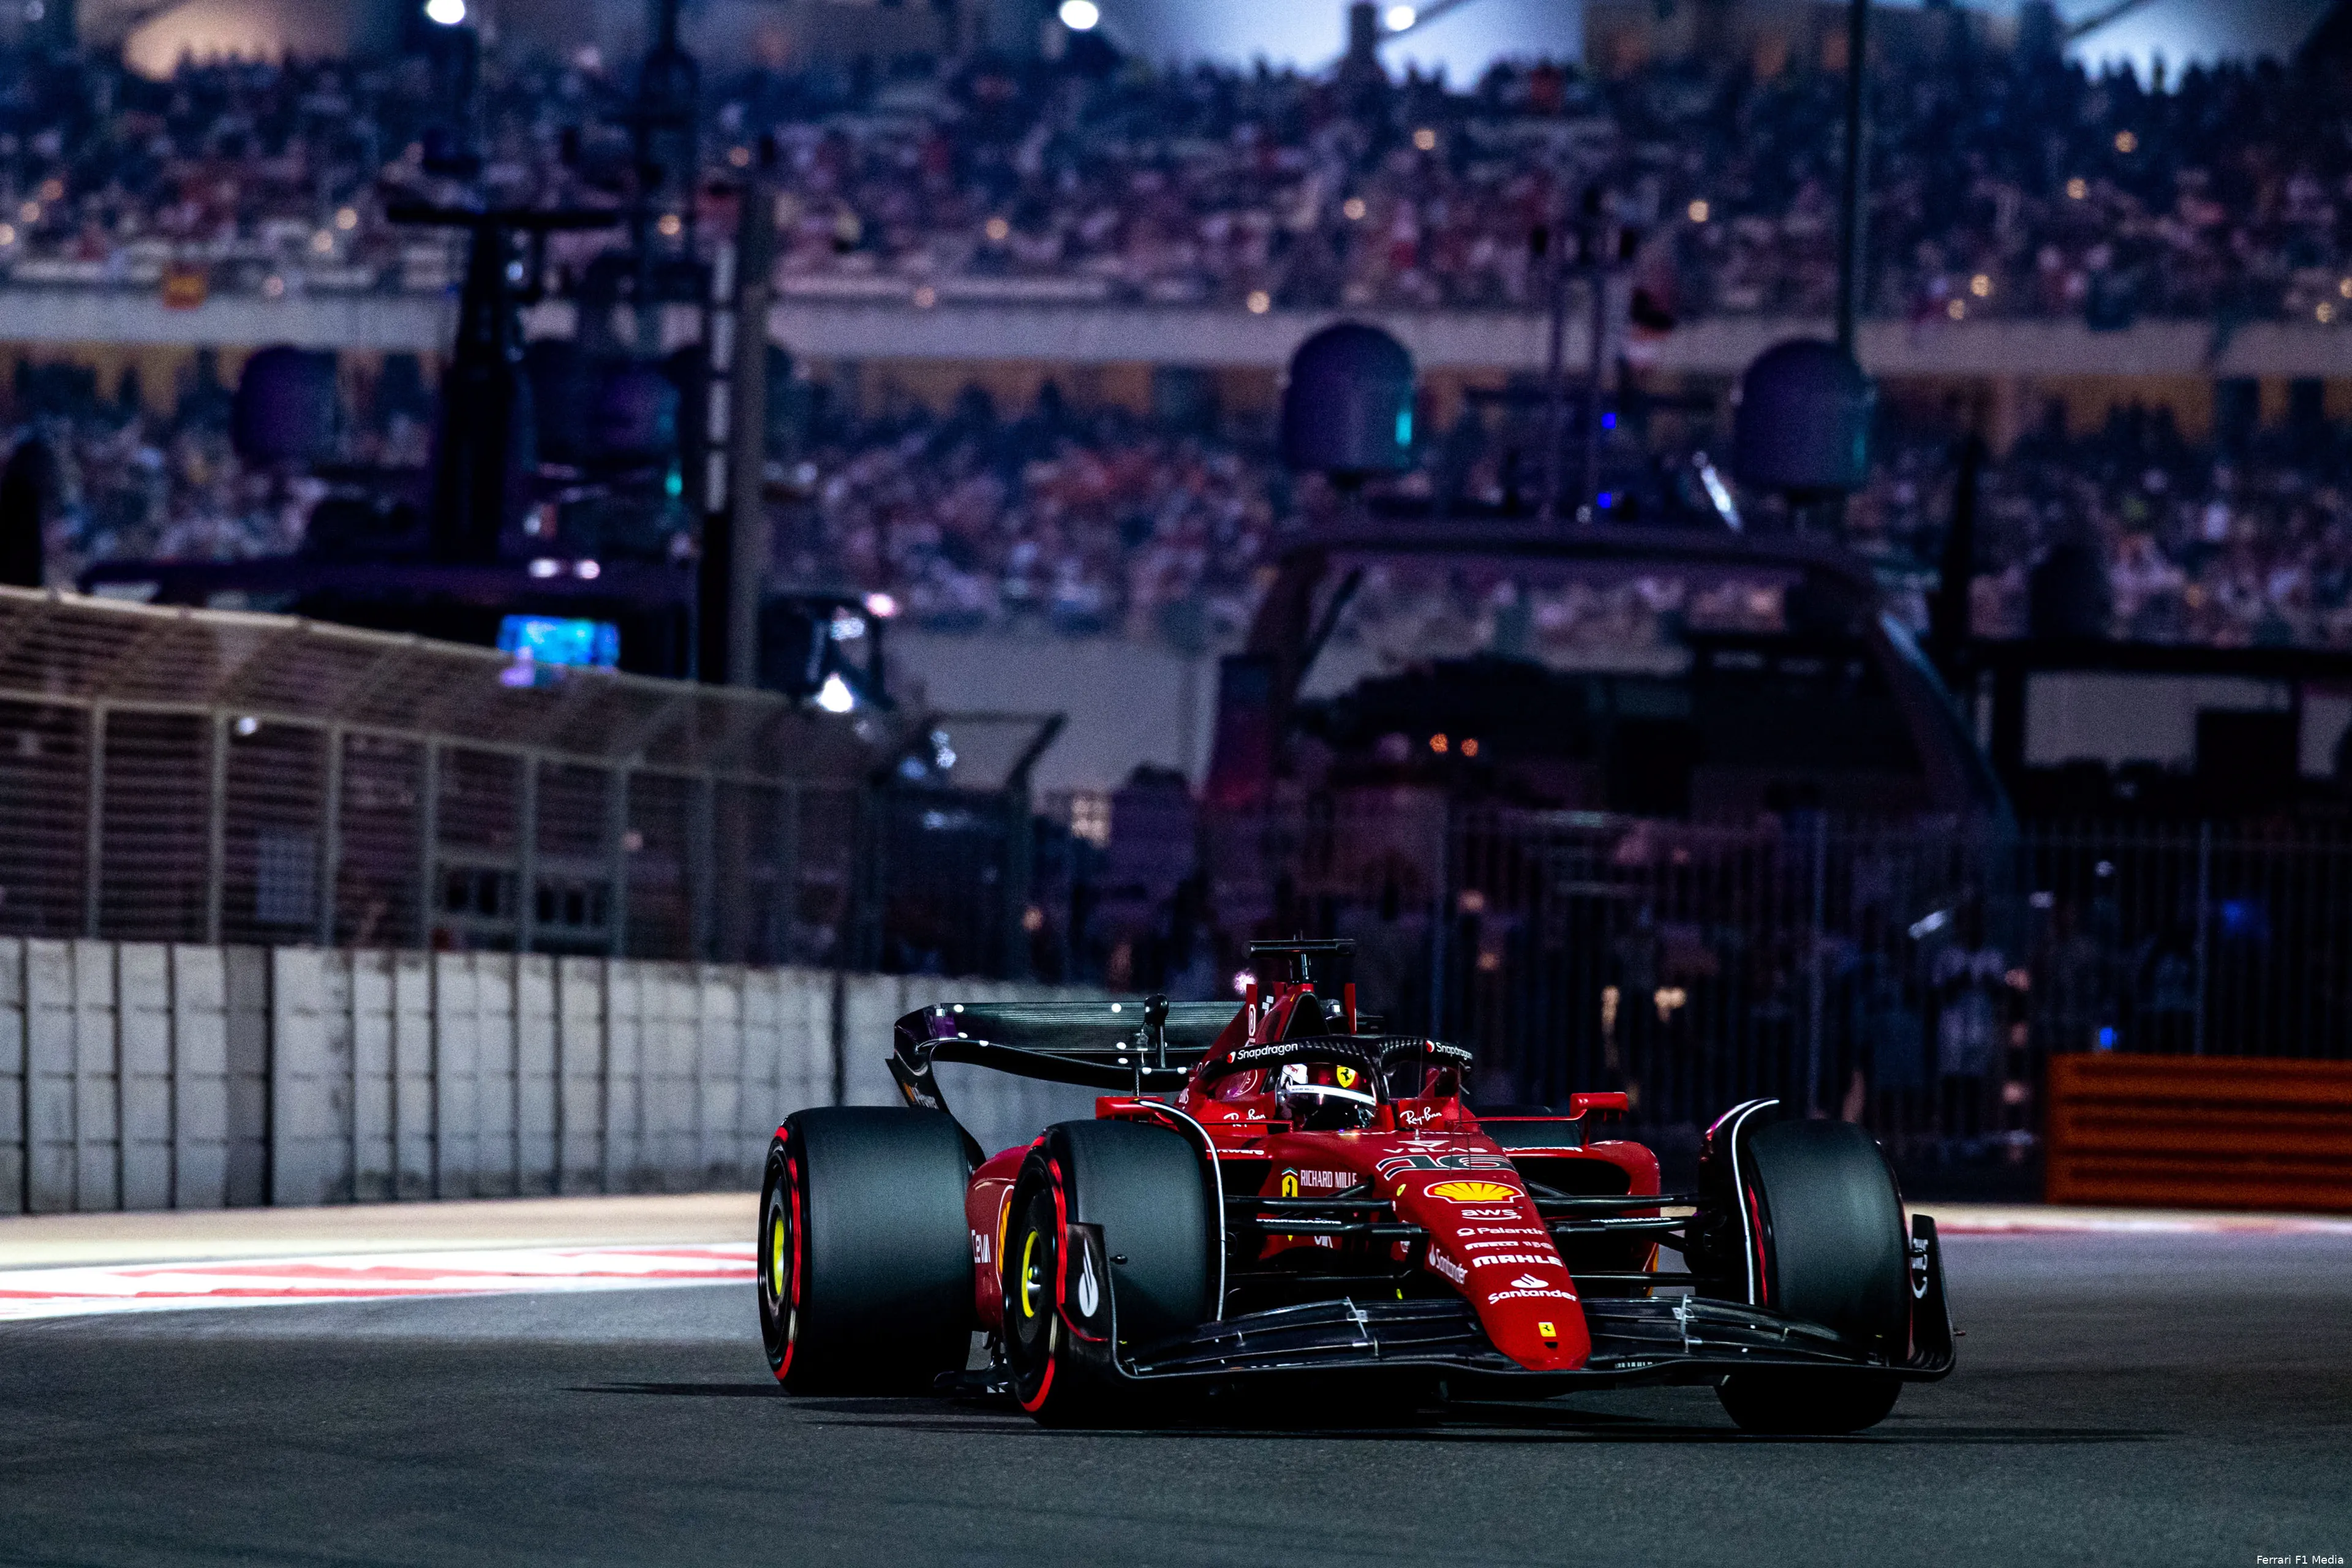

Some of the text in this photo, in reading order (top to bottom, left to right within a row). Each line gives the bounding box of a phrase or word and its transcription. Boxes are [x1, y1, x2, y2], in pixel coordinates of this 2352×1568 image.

[1237, 1043, 1298, 1059] Snapdragon
[1436, 1042, 1472, 1060] Snapdragon
[1400, 1107, 1442, 1125] Ray-Ban
[1376, 1155, 1518, 1181] 16
[1300, 1170, 1357, 1188] RICHARD MILLE
[1472, 1255, 1563, 1268] MAHLE
[1488, 1289, 1577, 1305] Santander
